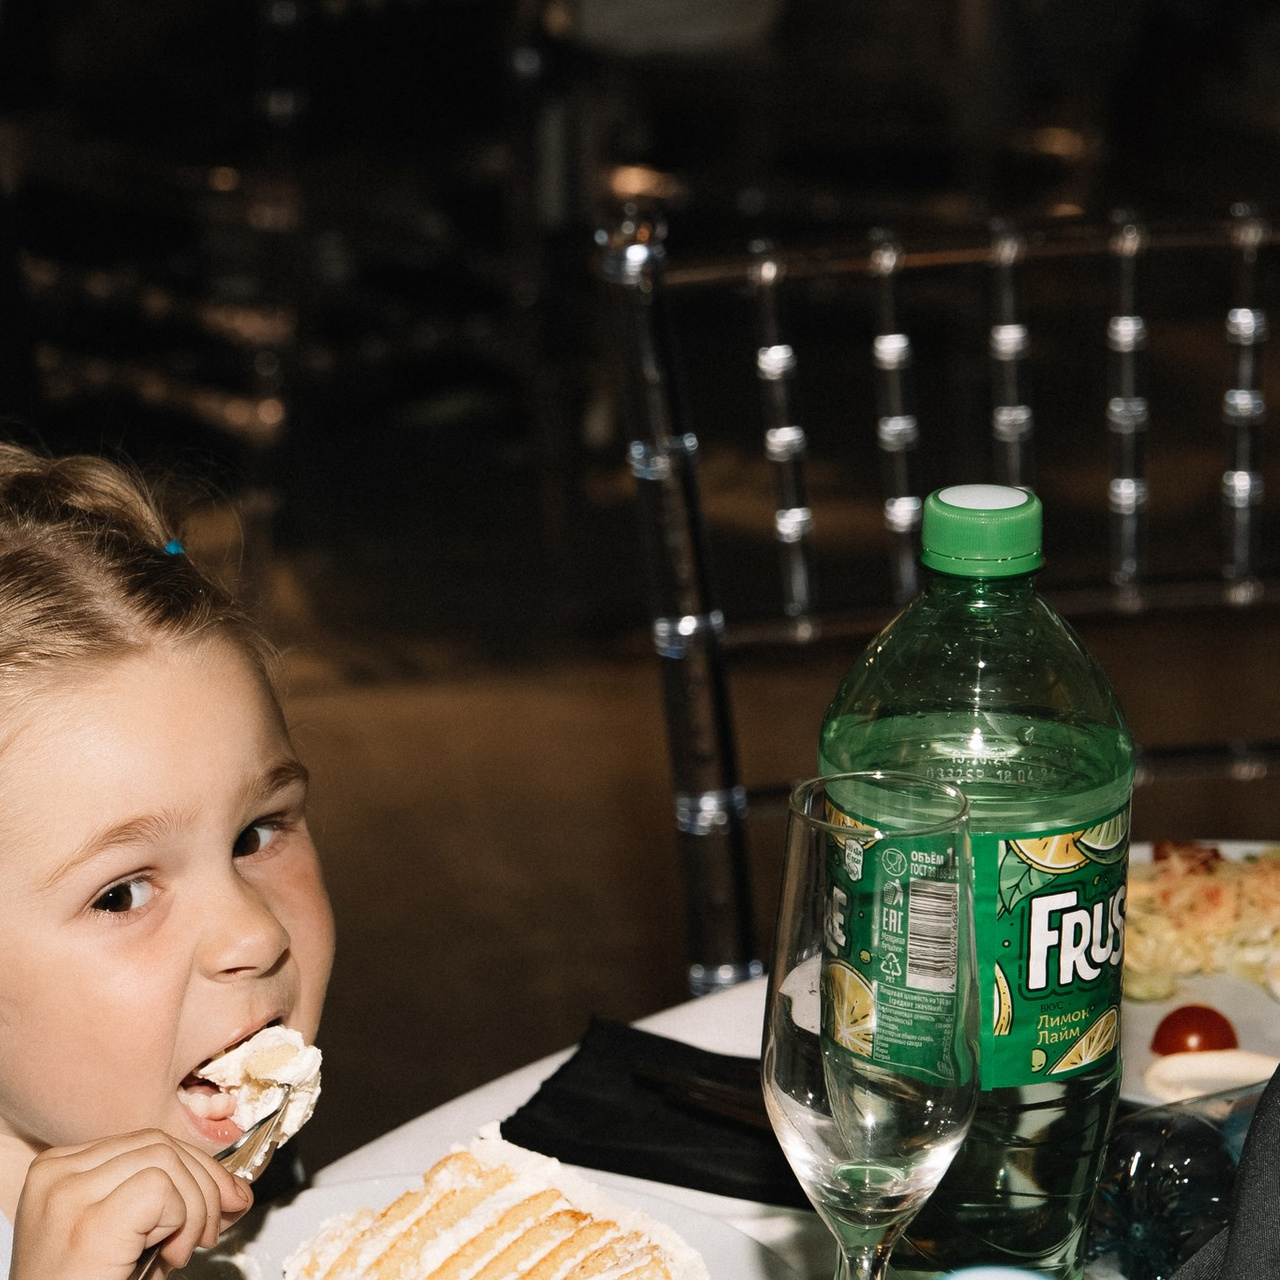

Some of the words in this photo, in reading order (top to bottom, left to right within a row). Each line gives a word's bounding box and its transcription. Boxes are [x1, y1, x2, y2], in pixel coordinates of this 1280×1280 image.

[910, 850, 944, 865] ОБЪЁМ
[910, 864, 927, 876] ГОСТ
[1037, 1008, 1089, 1030] Лимон
[1037, 1026, 1080, 1046] Лайм
